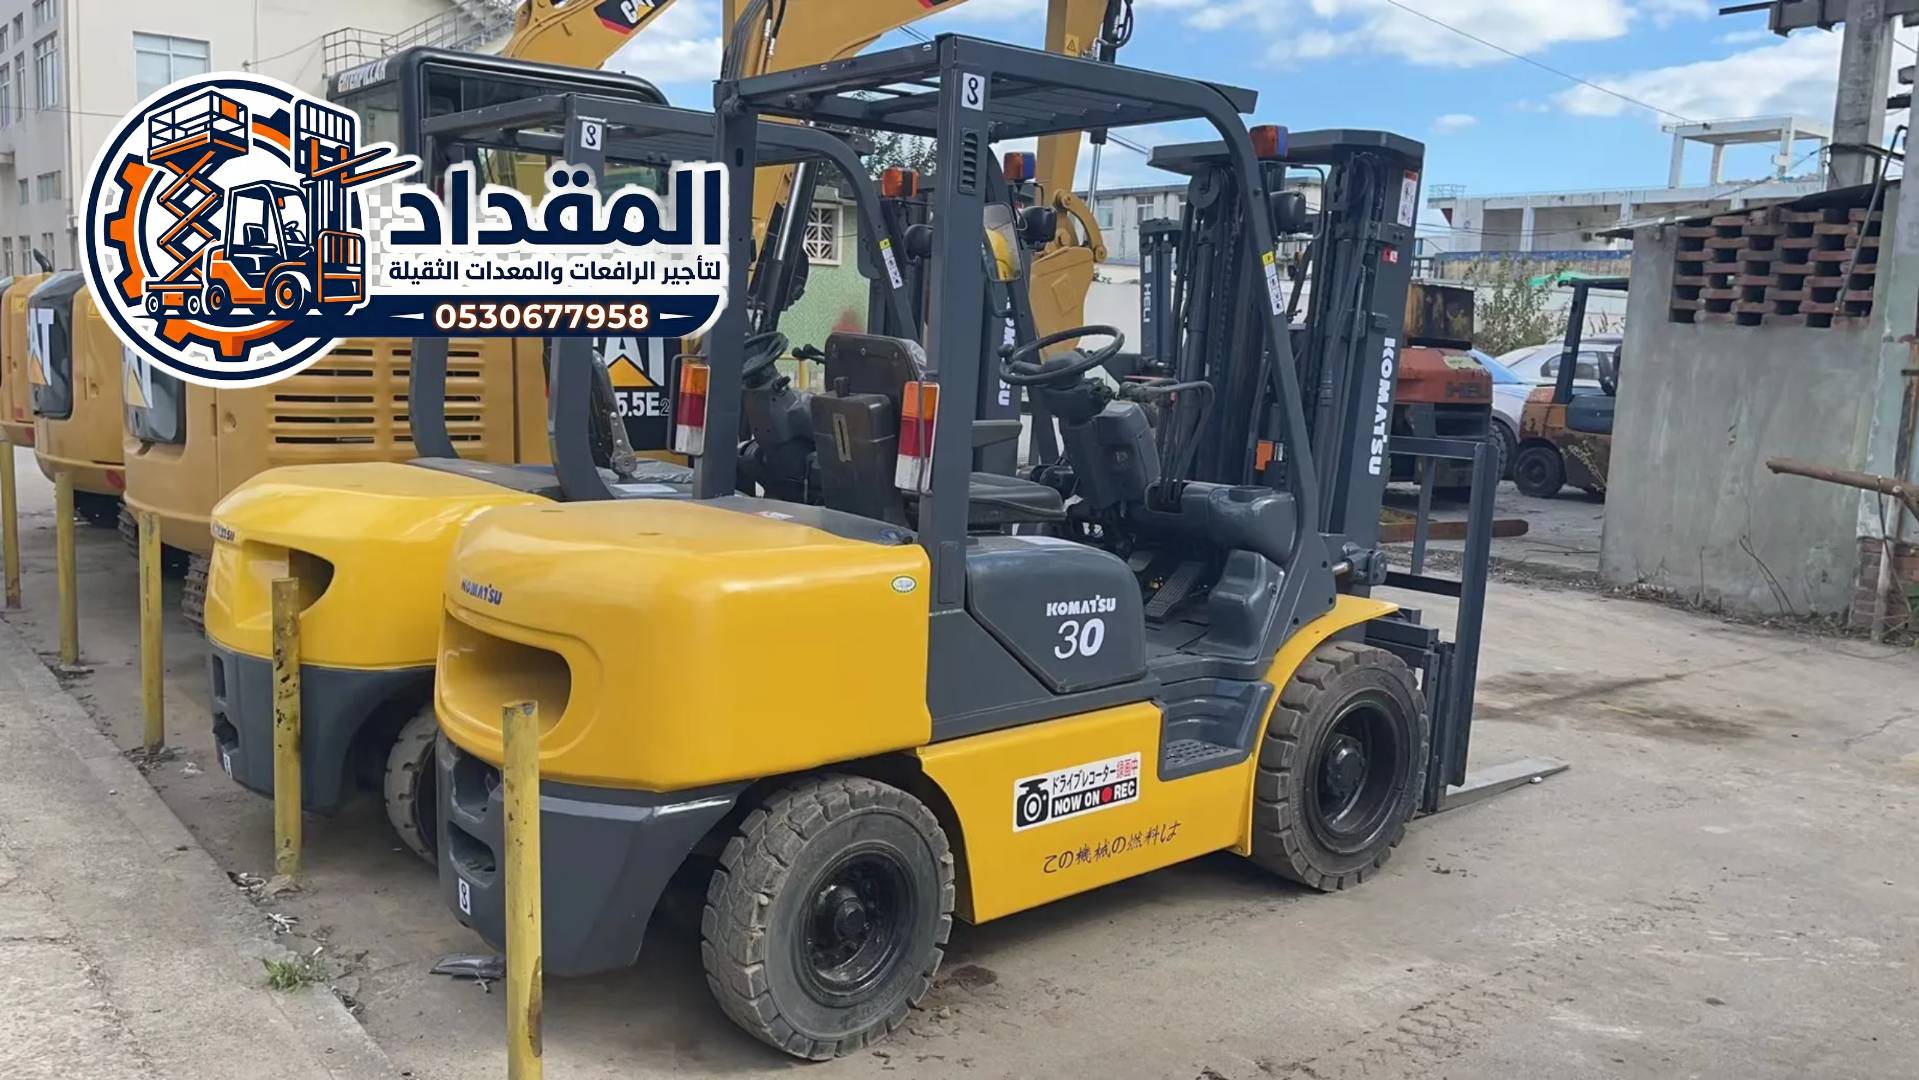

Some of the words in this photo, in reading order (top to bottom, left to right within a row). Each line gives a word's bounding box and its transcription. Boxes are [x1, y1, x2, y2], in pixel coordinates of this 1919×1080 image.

[1143, 283, 1152, 323] HELI
[1368, 337, 1396, 475] KOMATSU
[461, 580, 503, 606] KOMATSU
[1046, 594, 1117, 617] KOMATSU
[1054, 618, 1105, 660] 30
[1053, 794, 1083, 817] NOW
[1084, 789, 1100, 807] ON
[1113, 780, 1136, 799] REC
